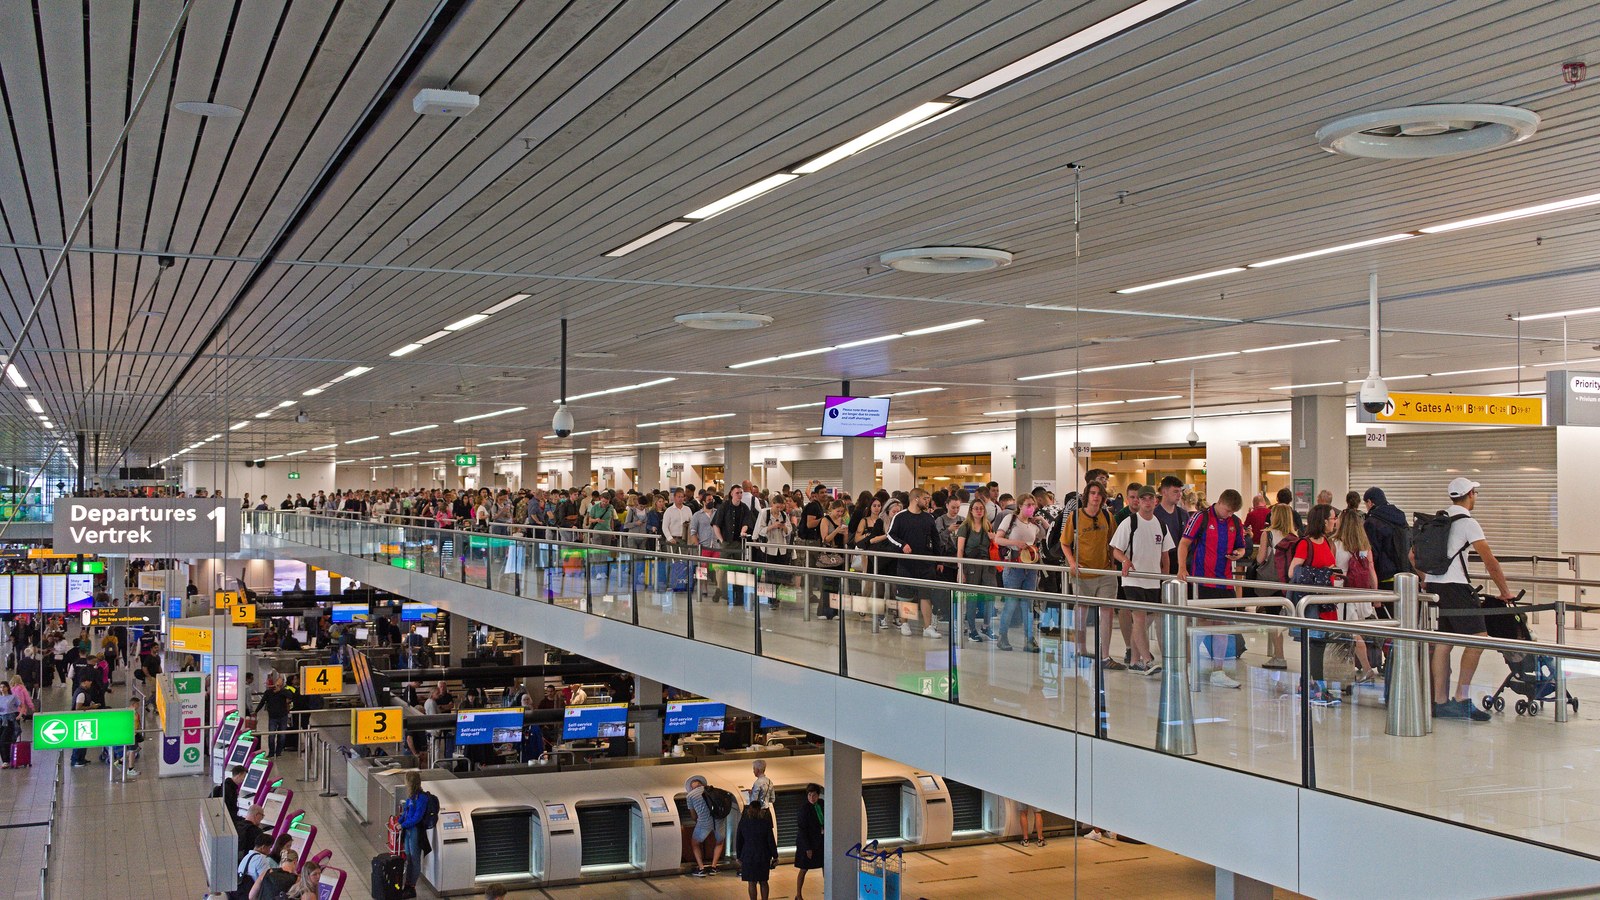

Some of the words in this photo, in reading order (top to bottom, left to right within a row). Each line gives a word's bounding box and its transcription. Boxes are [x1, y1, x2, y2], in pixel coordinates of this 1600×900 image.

[1415, 402, 1442, 413] Gates
[1367, 433, 1385, 441] 20-21
[71, 504, 197, 526] Departures
[206, 506, 226, 542] 1
[69, 525, 152, 544] Vertrek
[223, 593, 230, 604] 6
[239, 606, 246, 618] 5
[316, 669, 328, 685] 4
[373, 712, 387, 733] 3
